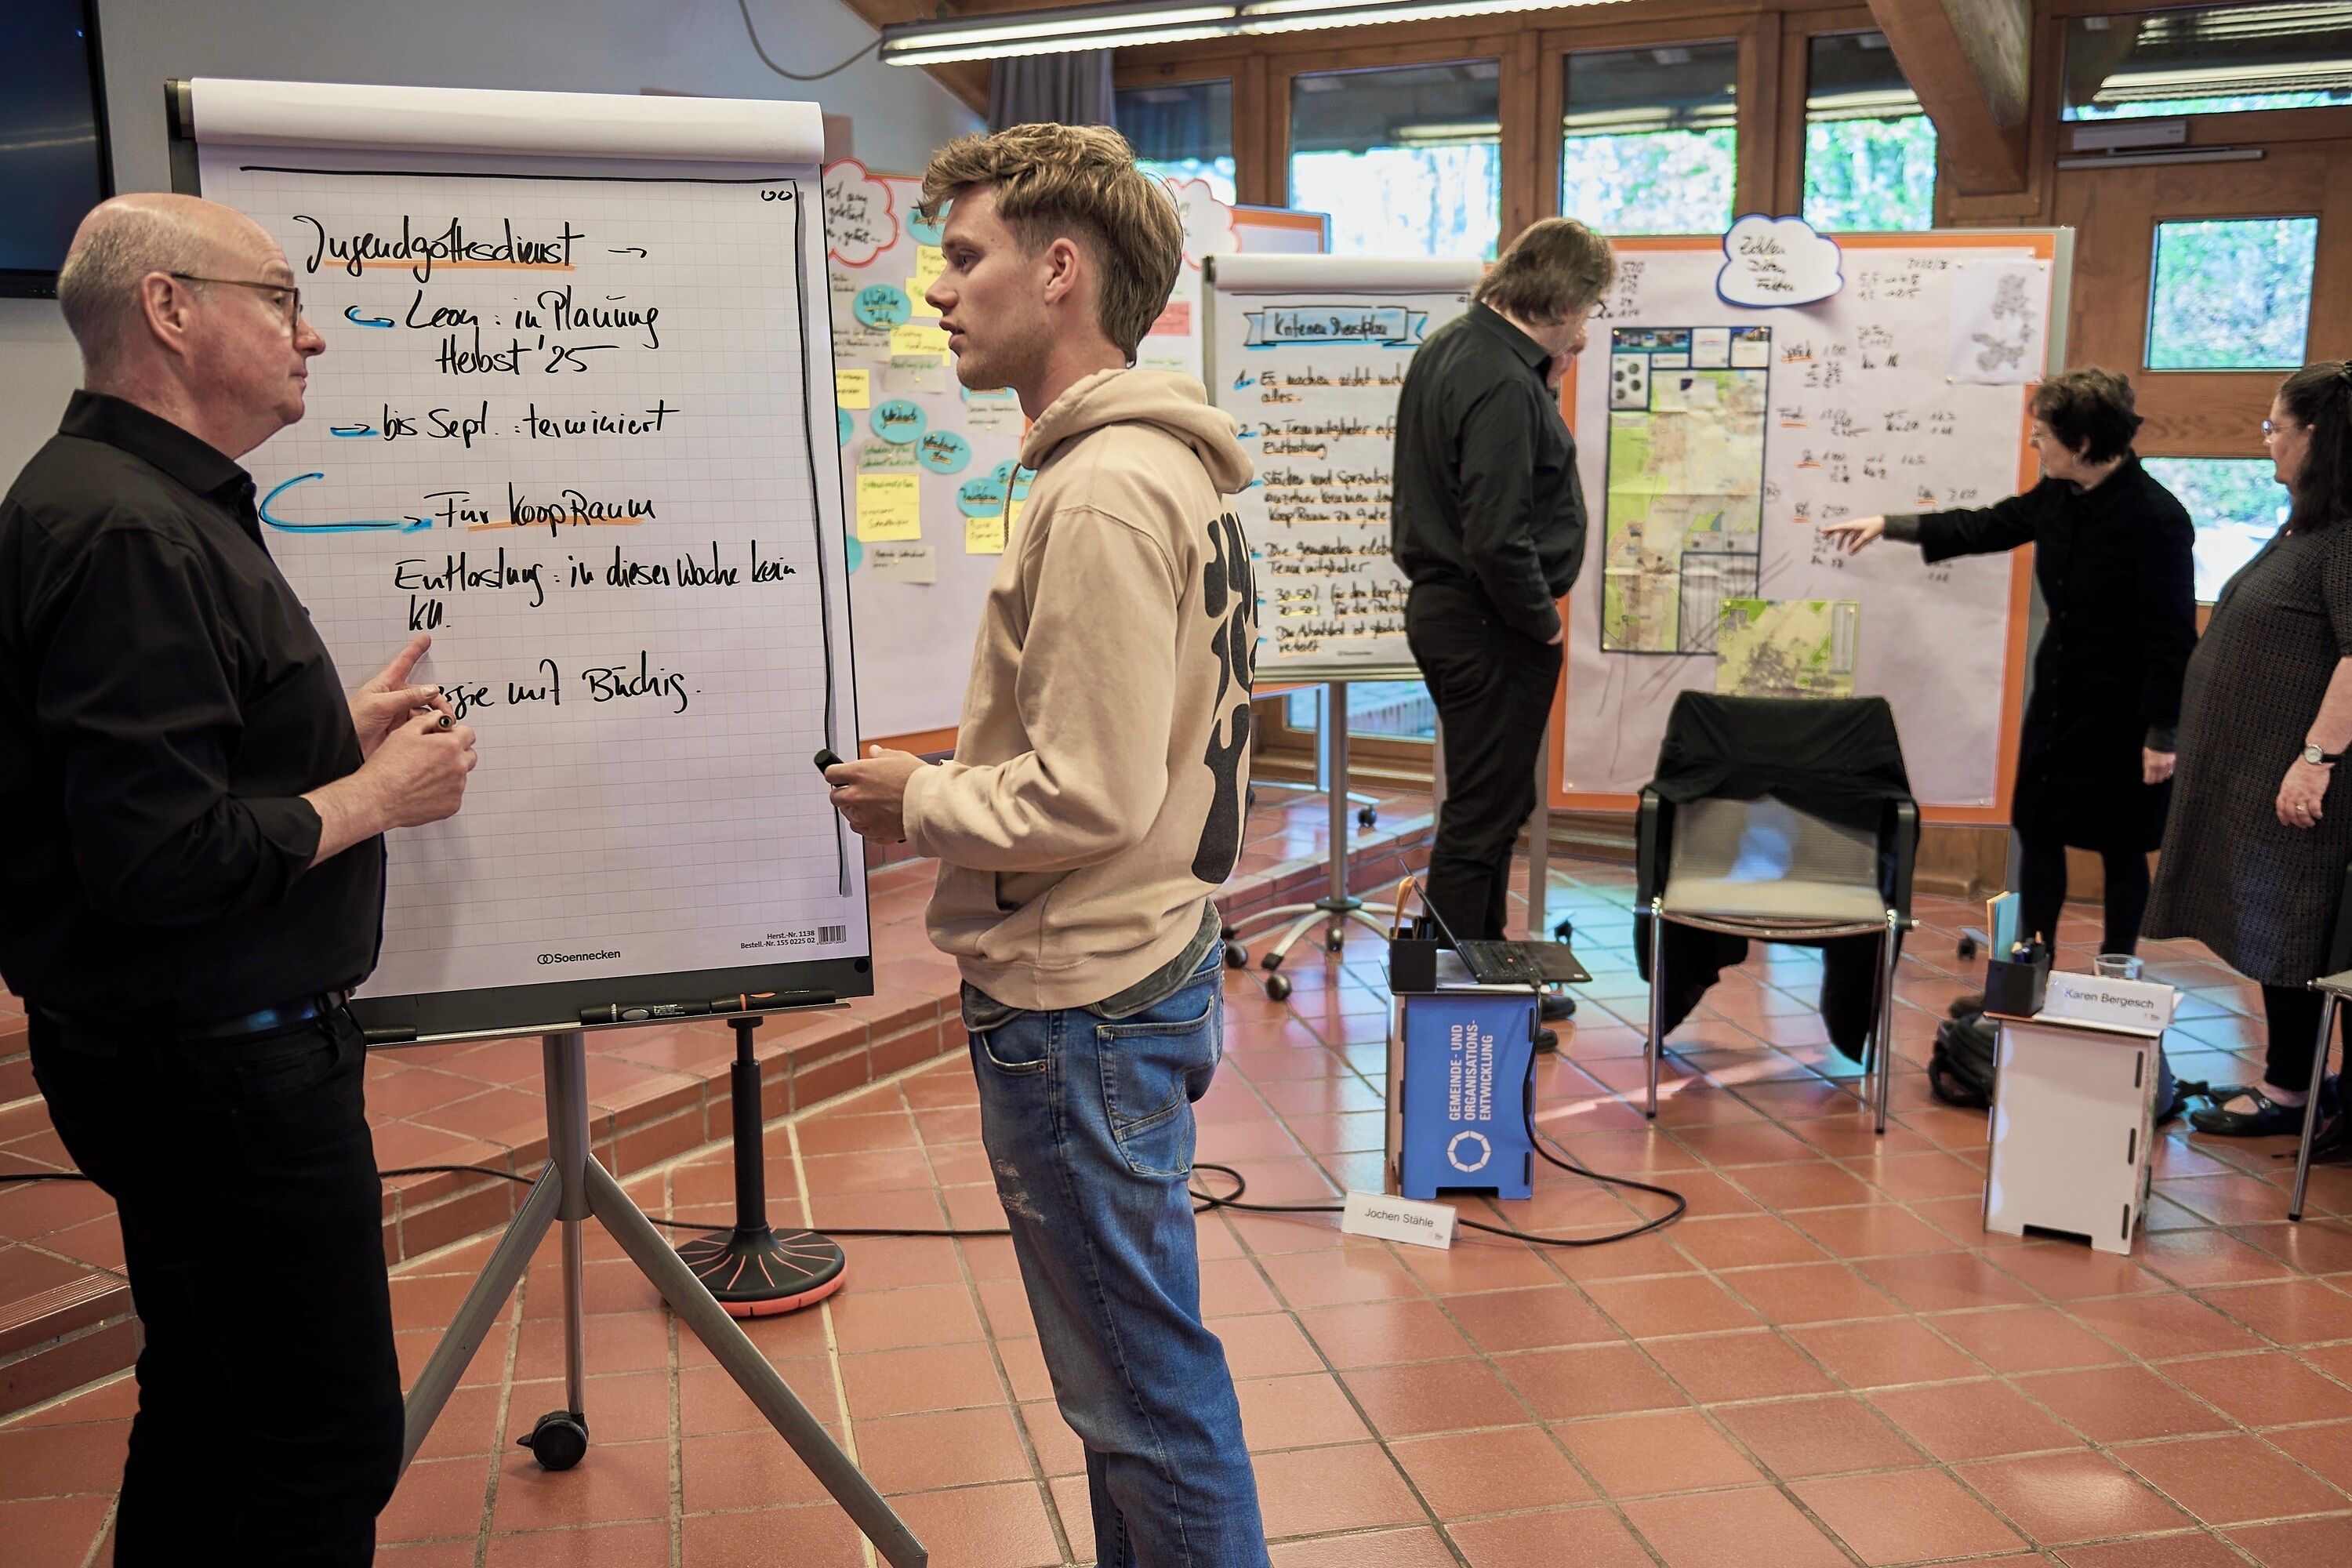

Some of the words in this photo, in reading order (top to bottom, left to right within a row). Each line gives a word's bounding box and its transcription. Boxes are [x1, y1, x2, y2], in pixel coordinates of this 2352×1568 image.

[294, 216, 585, 283] Jugendgottesdienst
[514, 296, 543, 329] in
[537, 285, 659, 349] Planung
[435, 327, 533, 375] Herbst
[383, 402, 418, 441] bis
[423, 491, 490, 528] Für
[395, 547, 543, 608] Entlastung
[569, 556, 594, 589] in
[606, 546, 670, 589] dieser
[677, 541, 739, 588] Woche
[508, 659, 560, 706] mit
[554, 949, 621, 963] Soennecken
[2064, 989, 2098, 1001] Karen
[2101, 993, 2154, 1007] Bergesch
[1450, 1025, 1463, 1051] UND
[1465, 1020, 1478, 1120] ORGANISATIONS-
[1479, 1035, 1493, 1120] ENTWICKLUNG
[1365, 1208, 1399, 1221] Jochen
[1403, 1214, 1434, 1228] Stähle
